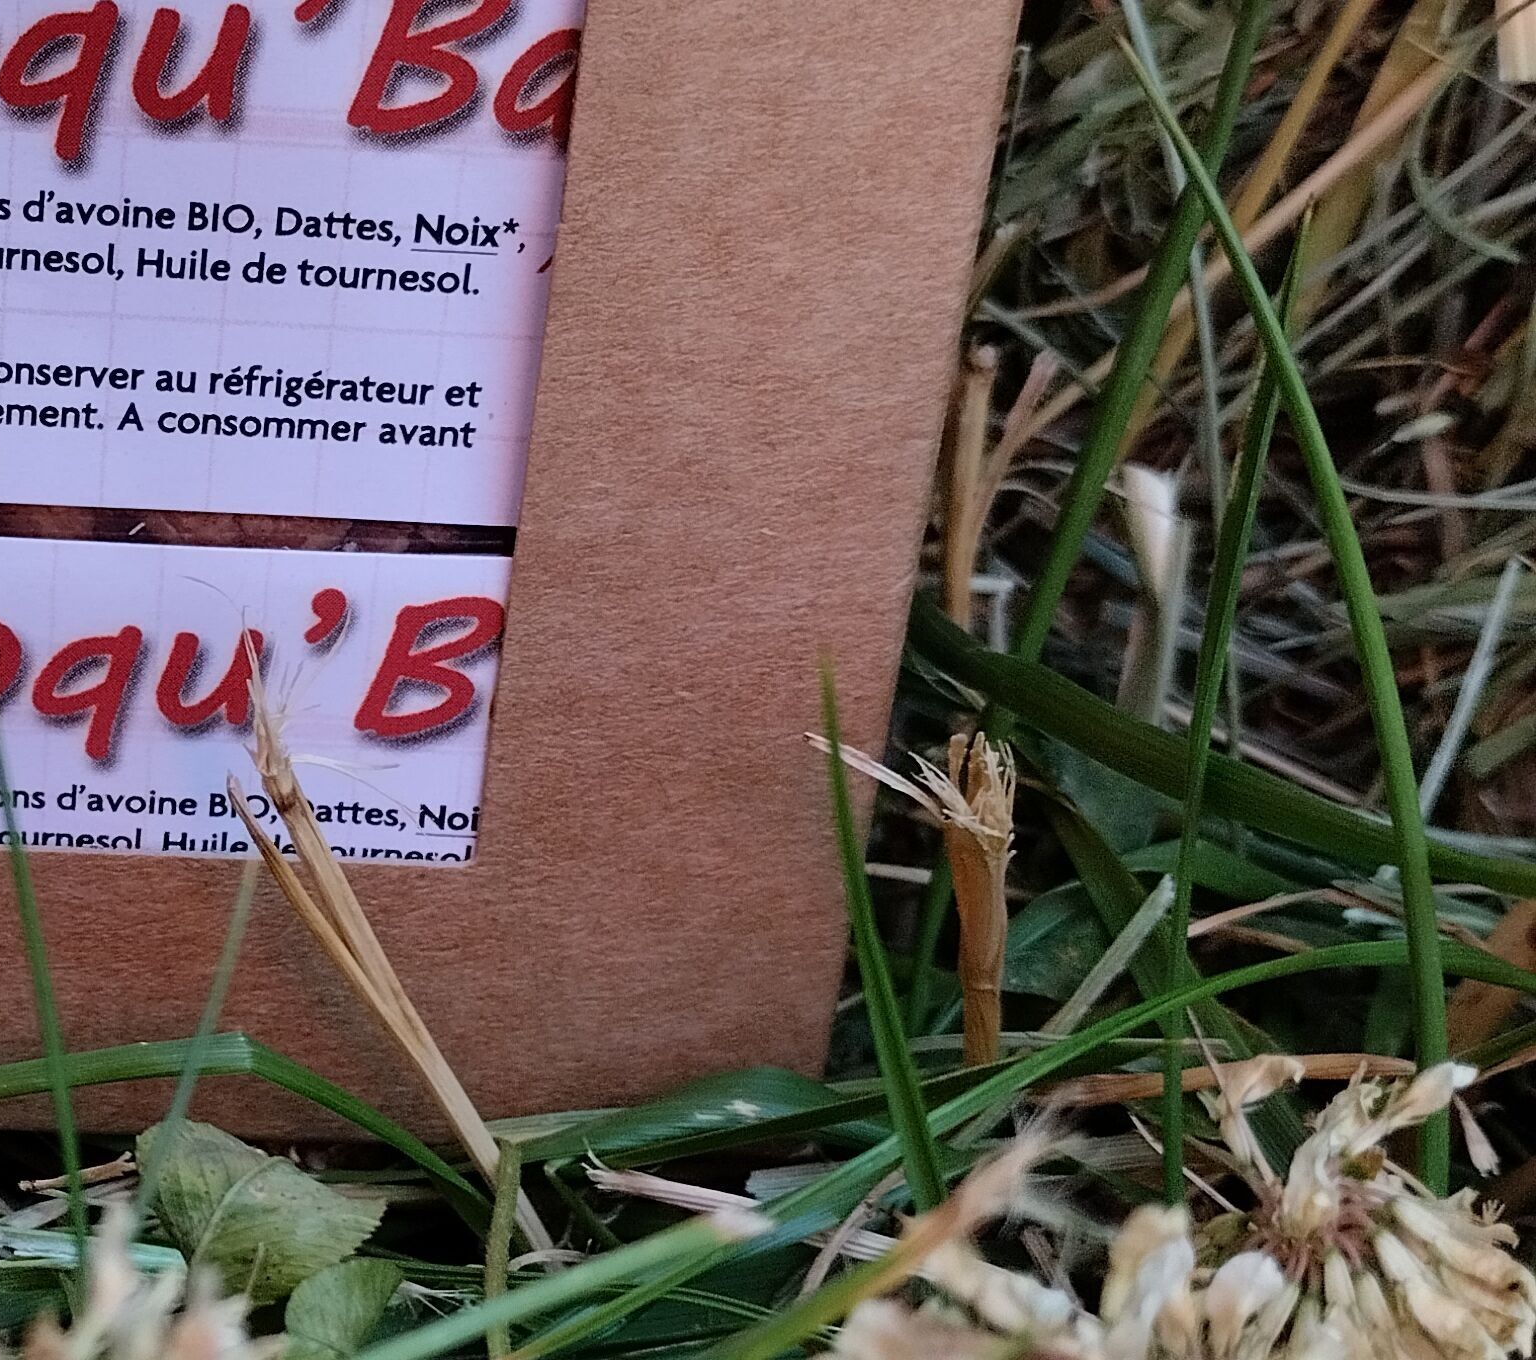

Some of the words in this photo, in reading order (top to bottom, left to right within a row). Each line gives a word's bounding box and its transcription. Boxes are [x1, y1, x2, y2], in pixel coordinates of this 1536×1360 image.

[187, 201, 263, 240] BIO,
[274, 206, 403, 247] Dattes,
[136, 246, 232, 283] Huile
[241, 250, 288, 285] de
[297, 258, 481, 297] tournesol.
[154, 367, 197, 394] au
[208, 363, 435, 408] réfrigérateur
[444, 381, 483, 409] et
[116, 401, 145, 433] A
[156, 408, 368, 444] consommer
[377, 417, 478, 449] avant
[307, 800, 407, 832] attes,
